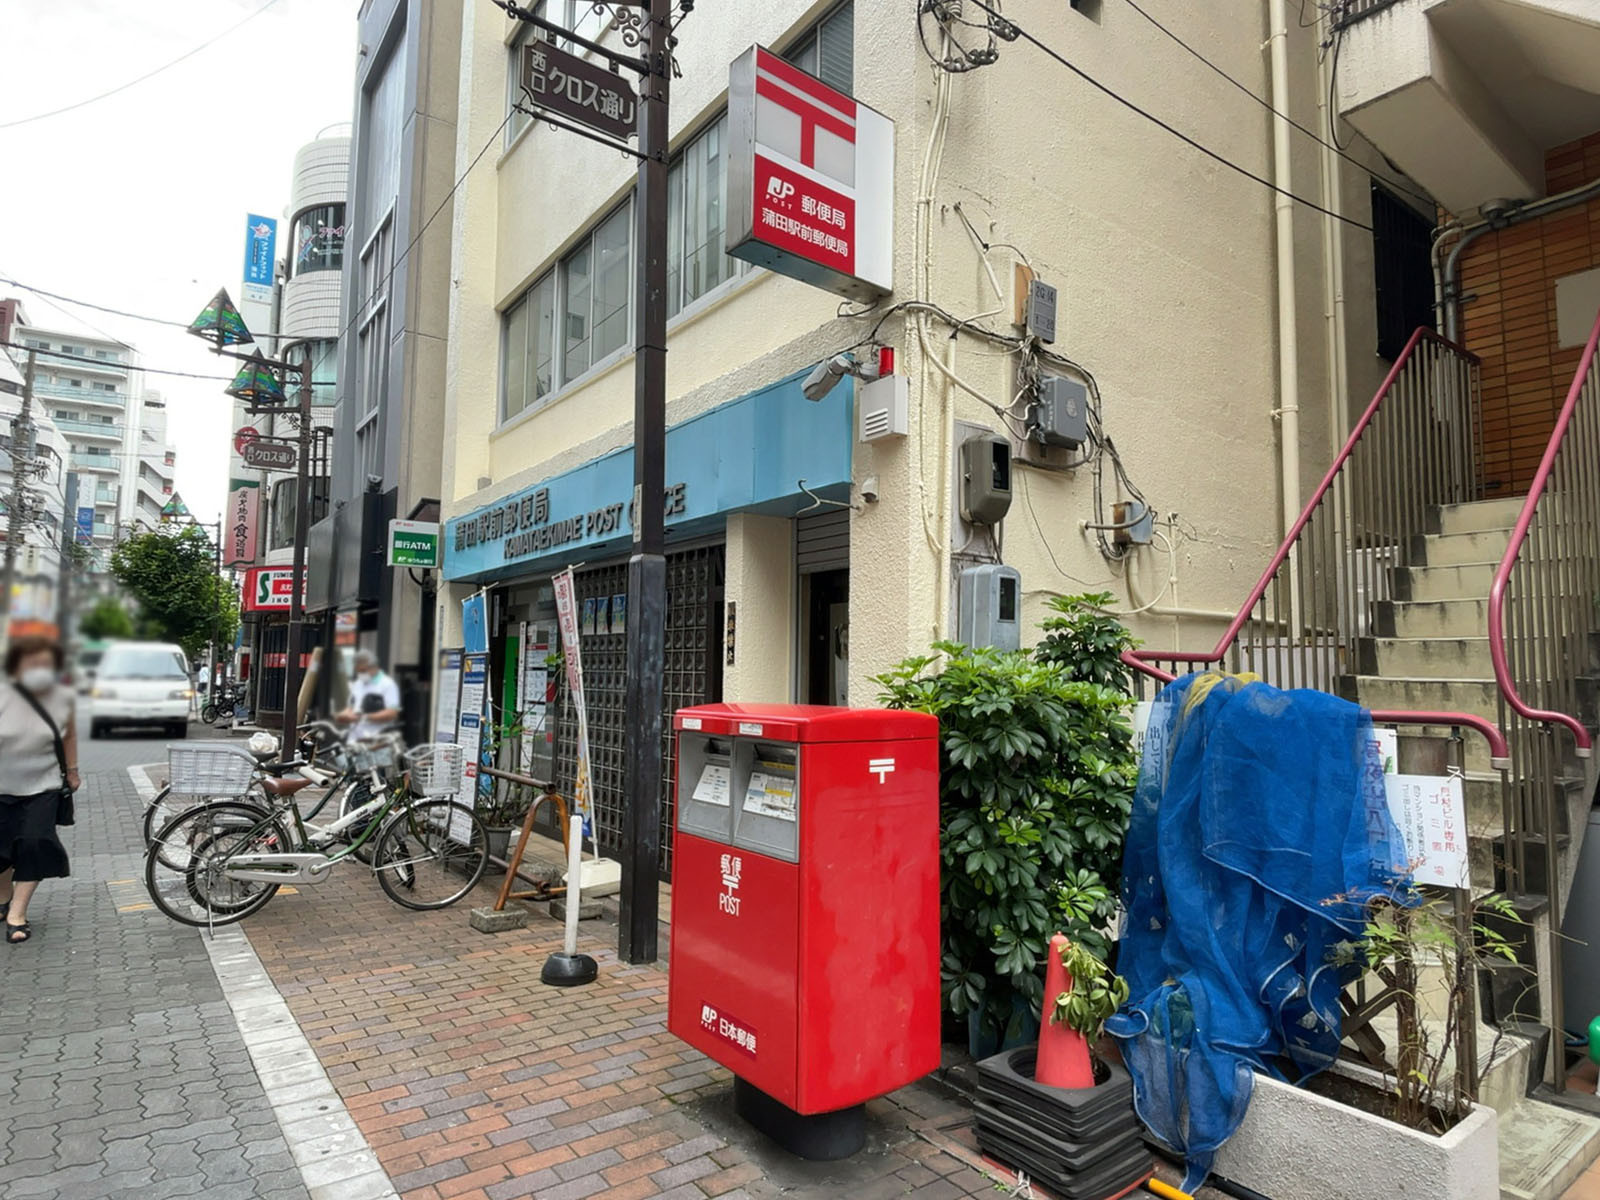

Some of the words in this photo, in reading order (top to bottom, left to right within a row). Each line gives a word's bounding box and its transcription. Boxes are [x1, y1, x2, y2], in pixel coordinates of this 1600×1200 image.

[531, 48, 547, 94] 西口
[548, 66, 635, 125] クロス通り
[765, 193, 793, 210] POST
[766, 175, 796, 199] JP
[801, 194, 846, 230] 郵便局
[762, 207, 849, 257] 蒲田駅前郵便局
[454, 487, 550, 552] 蒲田駅前郵便局
[504, 514, 584, 560] KAMATAEKIMAE
[586, 502, 624, 537] POST
[720, 853, 742, 880] 郵便
[719, 892, 741, 917] POST
[720, 1017, 757, 1054] 日本郵便
